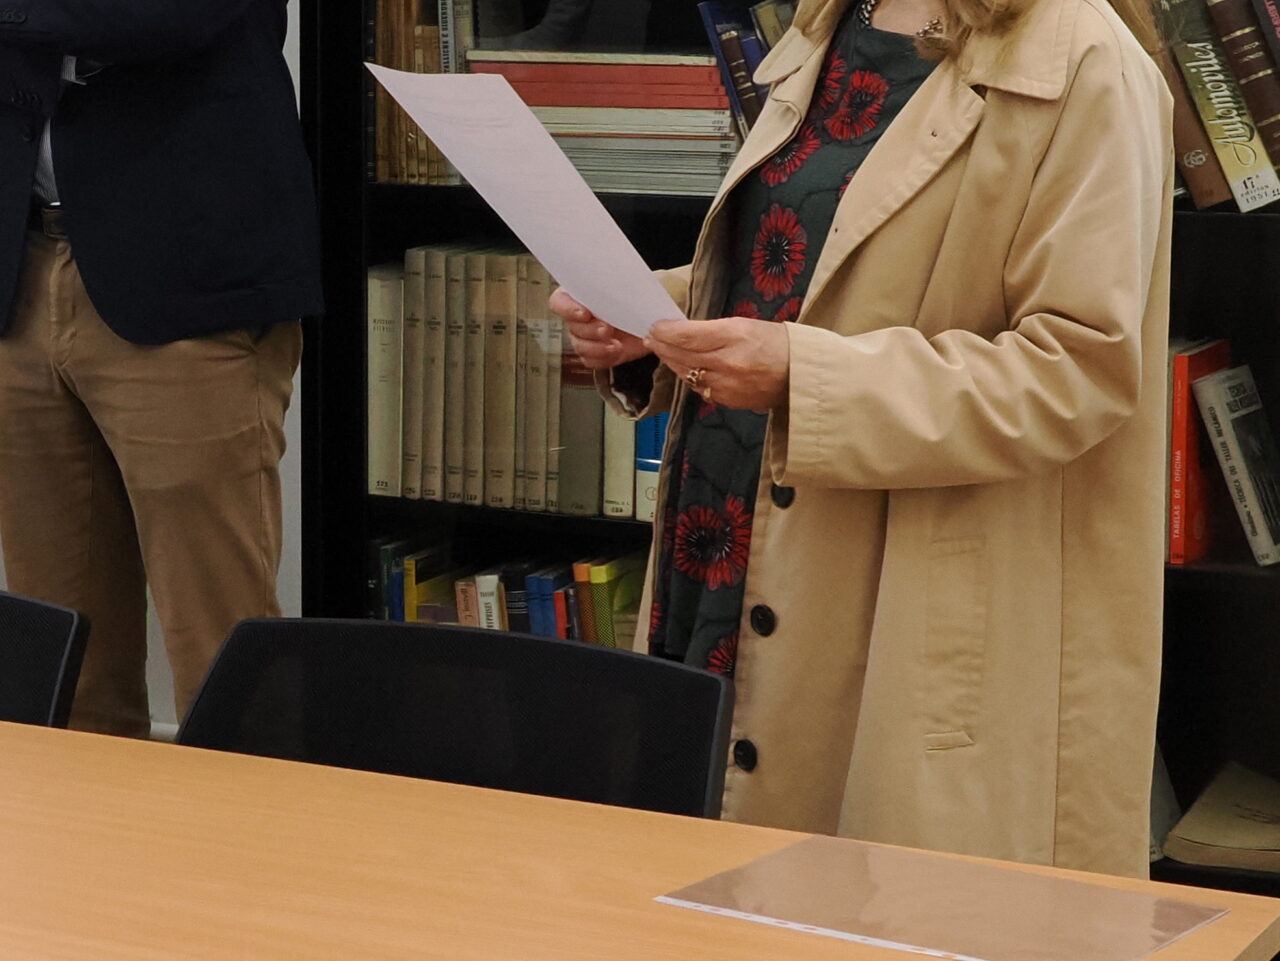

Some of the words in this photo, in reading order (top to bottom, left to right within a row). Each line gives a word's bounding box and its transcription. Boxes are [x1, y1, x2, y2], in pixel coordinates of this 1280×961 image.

[442, 40, 450, 73] TALLICHE
[1174, 449, 1182, 481] OFICINA
[1174, 488, 1181, 498] DE
[1173, 505, 1181, 539] TABELAS
